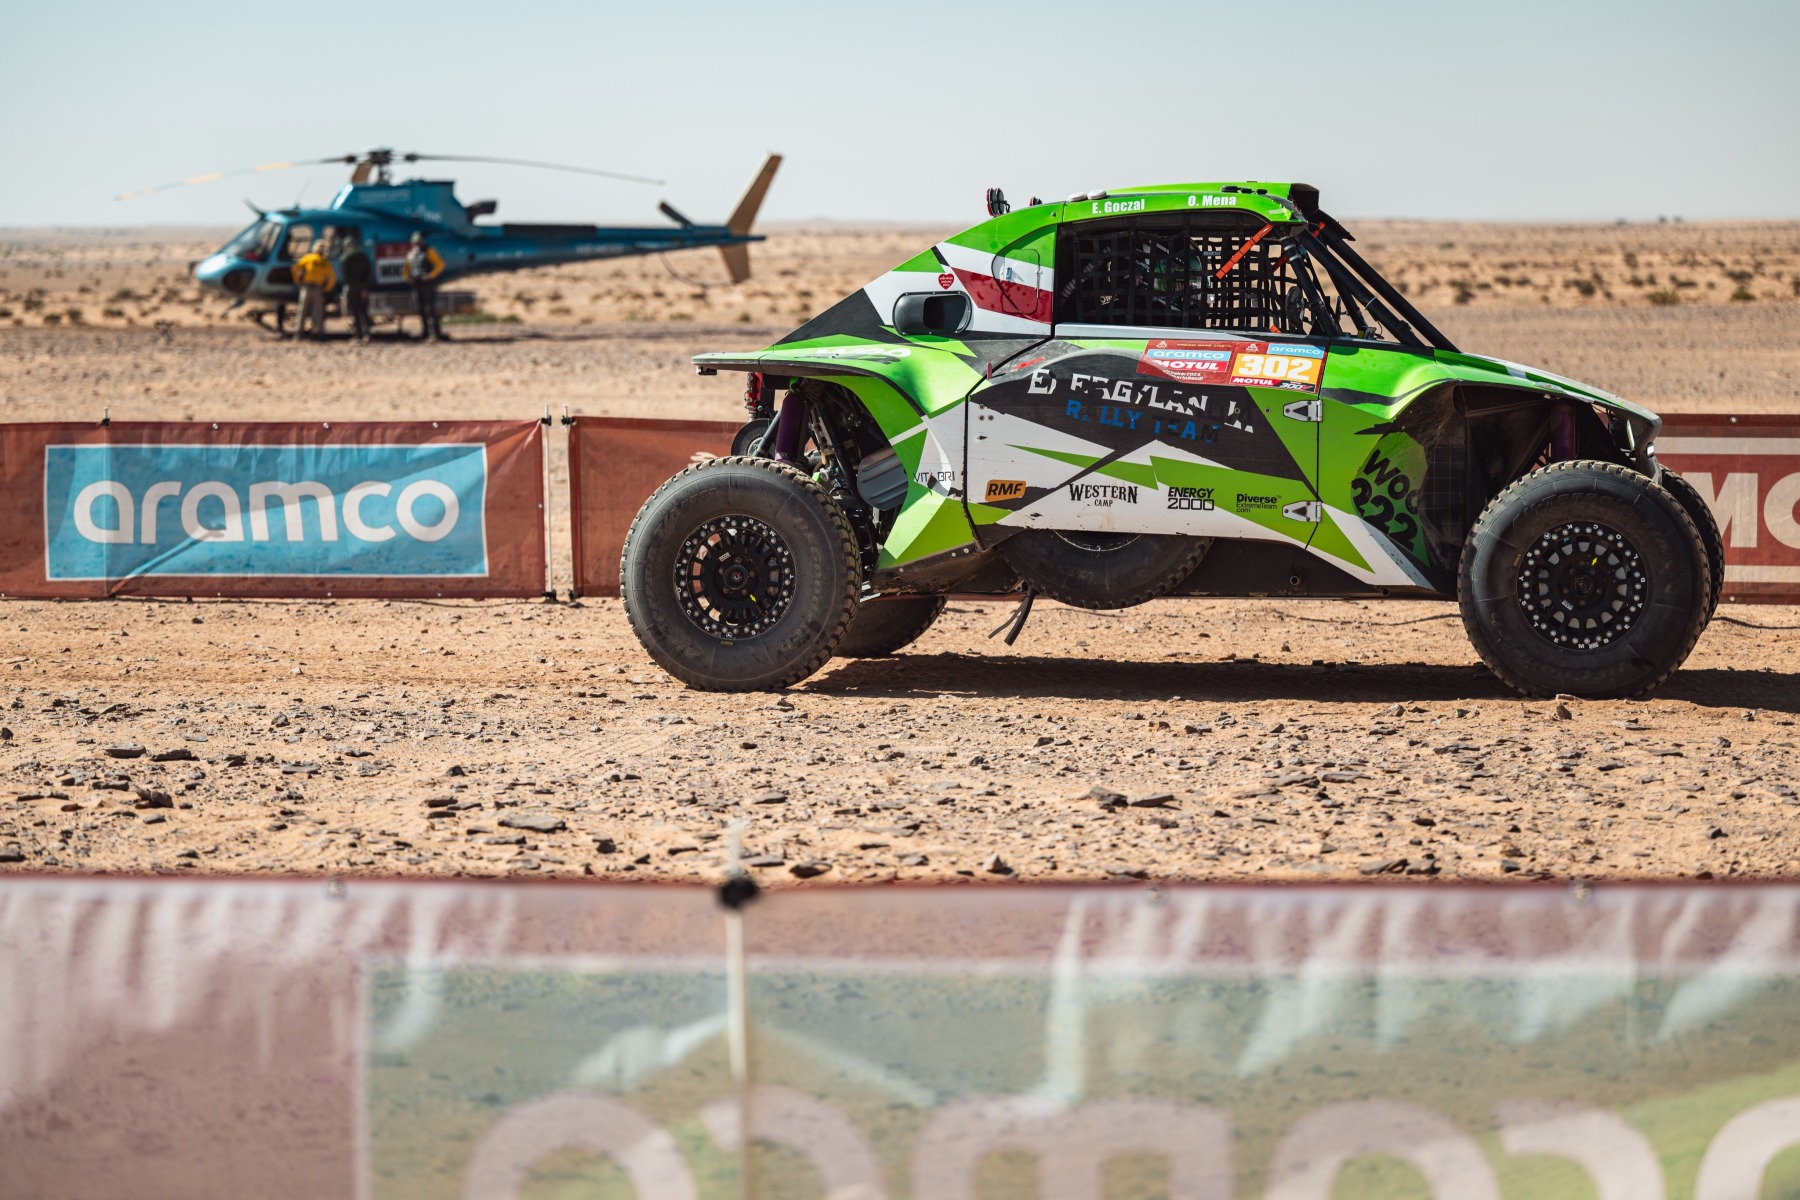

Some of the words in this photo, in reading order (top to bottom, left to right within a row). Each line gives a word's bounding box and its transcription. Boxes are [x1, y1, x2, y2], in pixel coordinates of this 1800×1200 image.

[1092, 203, 1102, 214] E.
[1104, 198, 1145, 213] Goczal
[1188, 195, 1199, 207] O.
[1202, 195, 1237, 206] Mena
[1153, 350, 1225, 360] aramco
[1271, 346, 1321, 354] aramco
[1151, 359, 1219, 370] MOTUL
[1238, 355, 1313, 381] 302
[1232, 377, 1274, 386] MOTUL
[988, 483, 1023, 496] RMF
[1069, 483, 1138, 504] WESTERN
[1168, 486, 1215, 499] ENERGY
[1094, 499, 1113, 507] CAMP
[1167, 498, 1215, 511] 2000
[1236, 502, 1277, 510] ExtremeTeam
[73, 479, 461, 545] aramco
